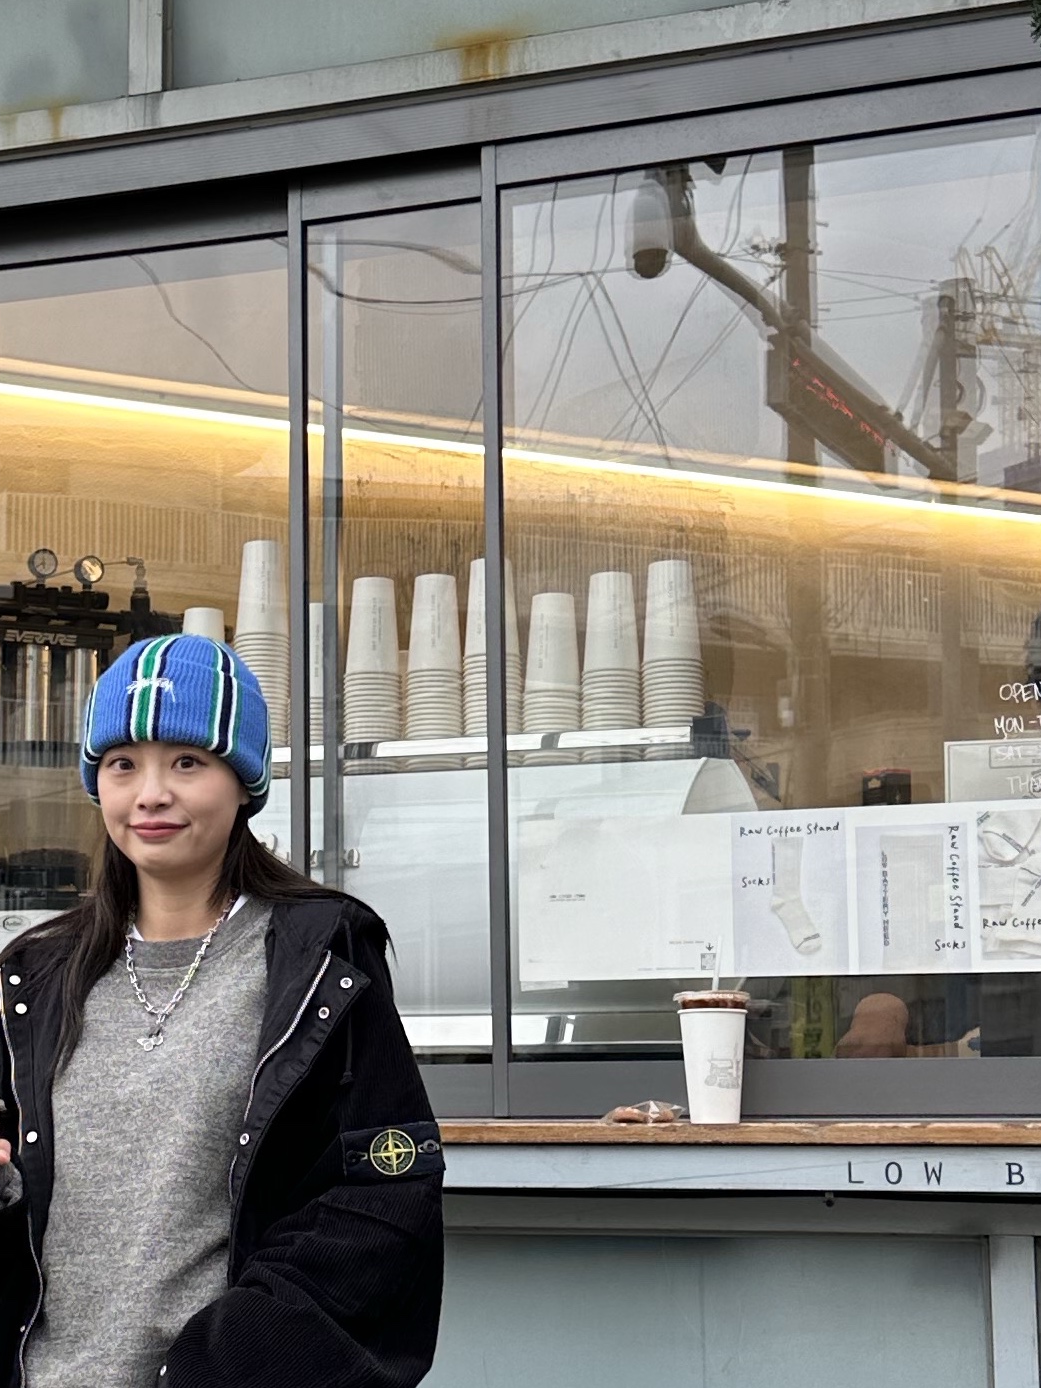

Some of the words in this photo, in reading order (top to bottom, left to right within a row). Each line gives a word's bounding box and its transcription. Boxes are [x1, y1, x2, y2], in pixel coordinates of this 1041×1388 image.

[3, 629, 78, 647] EVERPURE
[999, 682, 1041, 703] OPEN
[993, 715, 1024, 740] MON
[739, 826, 763, 837] Raw
[767, 826, 803, 837] Coffee
[806, 821, 839, 835] Stand
[948, 825, 959, 849] Raw
[742, 876, 770, 888] Socks
[946, 854, 960, 890] Coffee
[949, 895, 964, 929] Stand
[982, 918, 1007, 929] Raw
[935, 938, 966, 951] Socks
[848, 1161, 943, 1186] LOW
